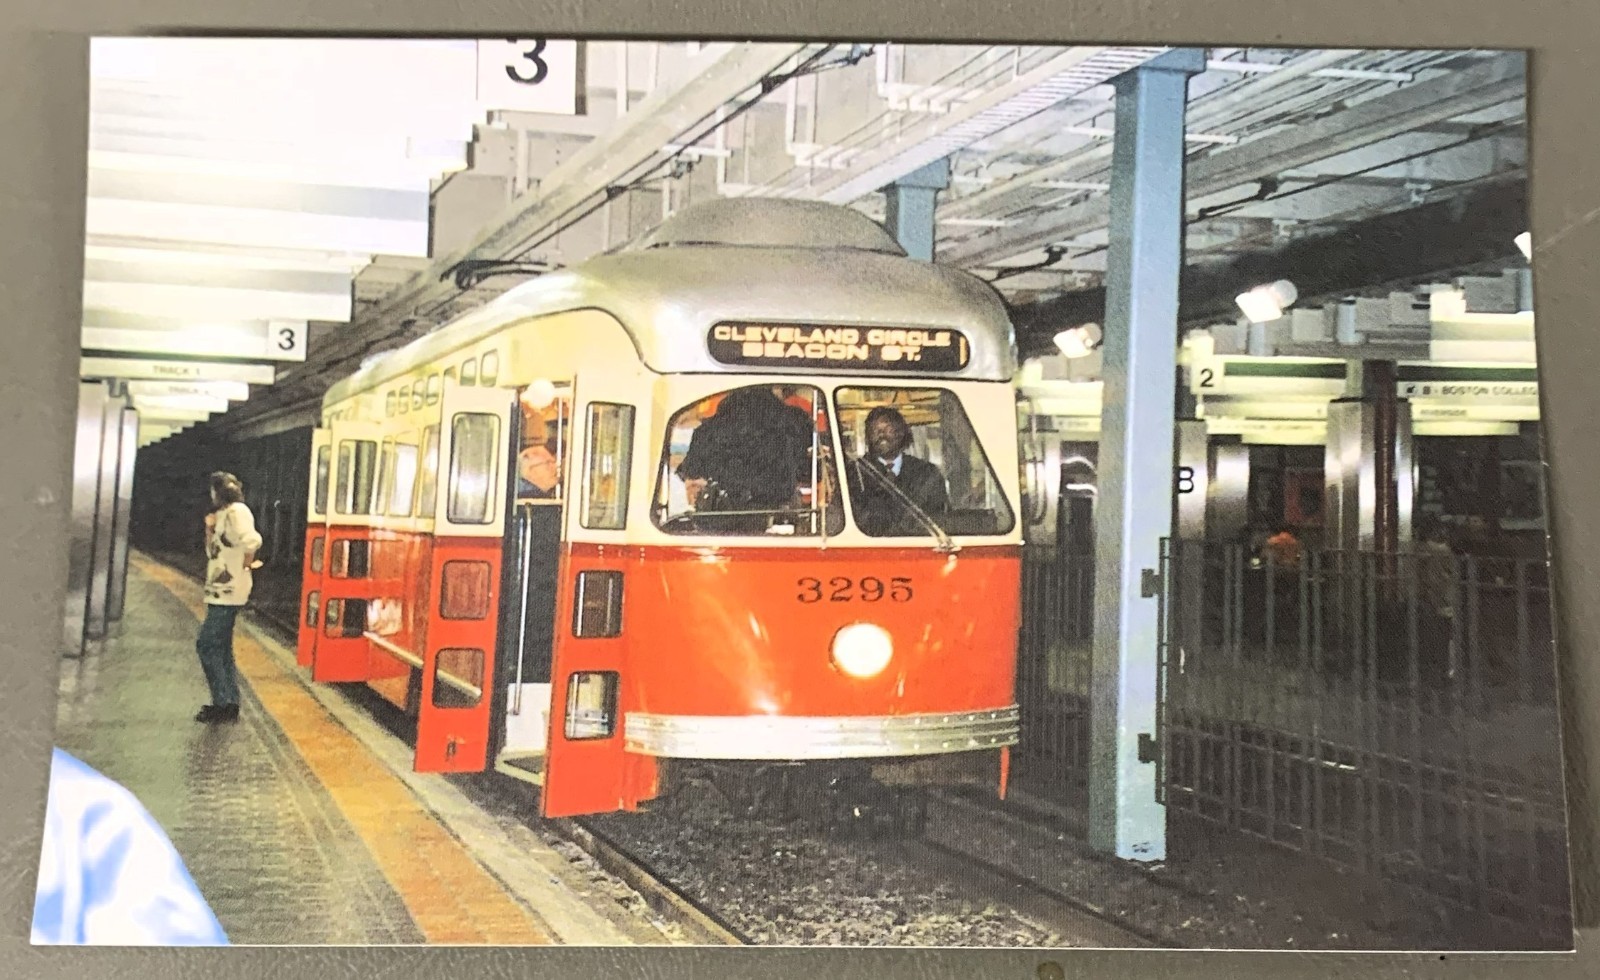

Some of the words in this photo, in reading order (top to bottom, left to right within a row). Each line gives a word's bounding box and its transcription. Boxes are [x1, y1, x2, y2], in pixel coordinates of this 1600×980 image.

[505, 38, 549, 86] 3
[278, 328, 296, 351] 3
[714, 325, 860, 345] CLEVELAND
[867, 328, 951, 347] CIRCLE
[742, 342, 869, 361] BEACON
[881, 345, 922, 362] ST.
[152, 364, 190, 376] TRACK
[1199, 368, 1214, 388] 2
[1441, 385, 1490, 397] BOSTON
[797, 576, 914, 604] 3295
